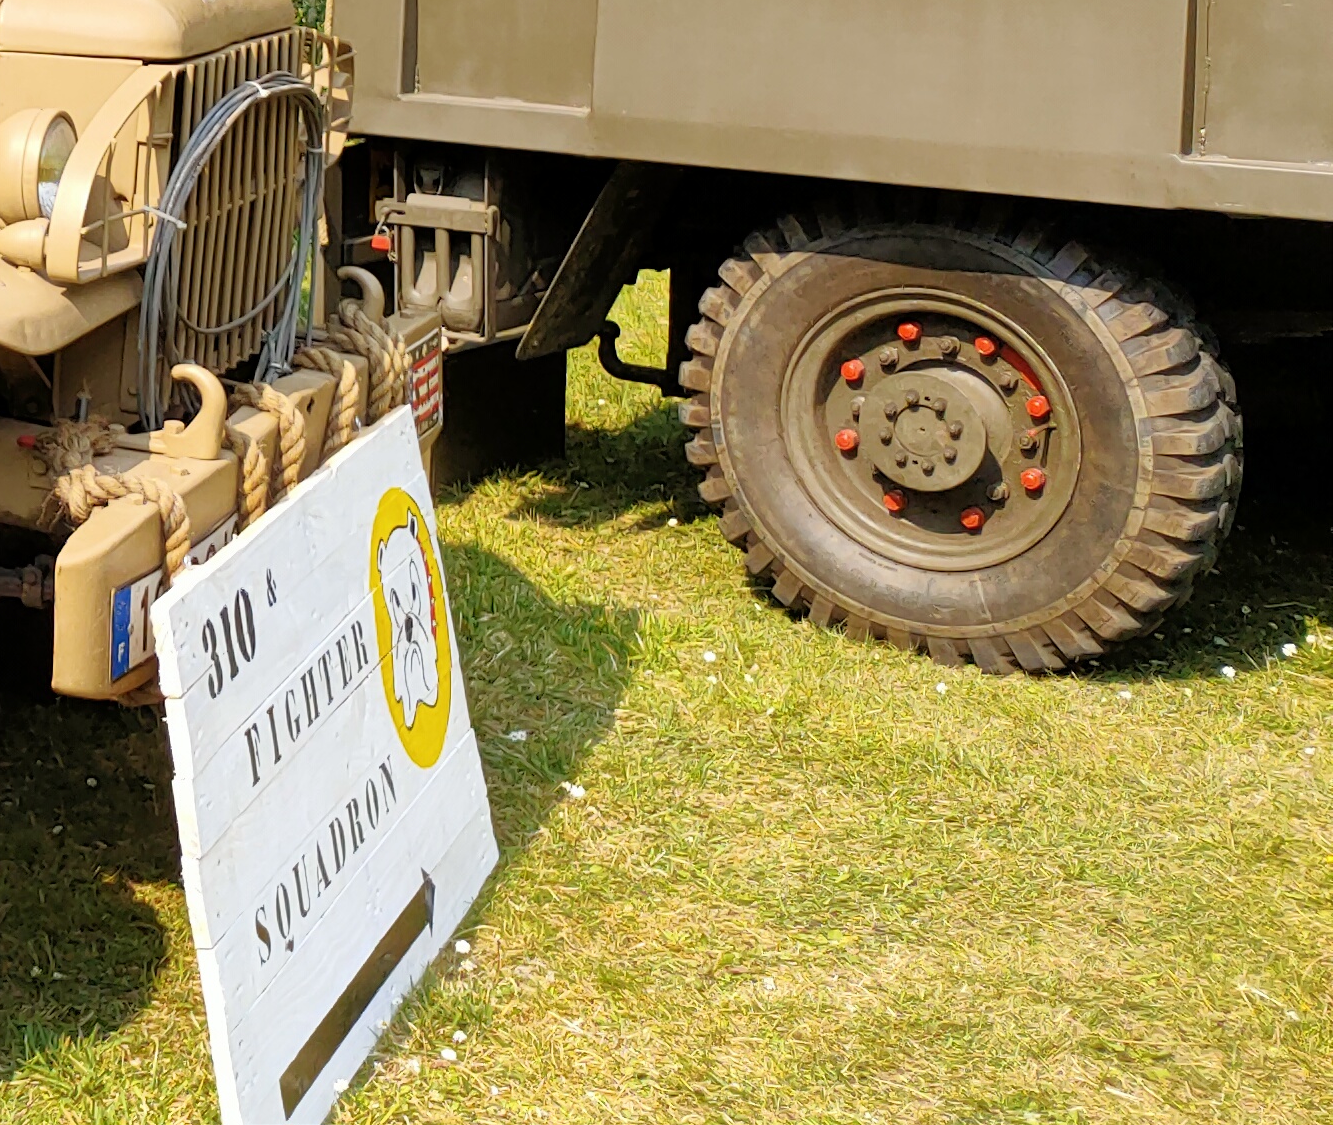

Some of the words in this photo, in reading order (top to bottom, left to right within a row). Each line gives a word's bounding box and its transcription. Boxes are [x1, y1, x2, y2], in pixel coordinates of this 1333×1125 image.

[201, 586, 256, 700] 310
[244, 620, 369, 787] FIGHTER
[254, 754, 397, 968] SQUADRON
